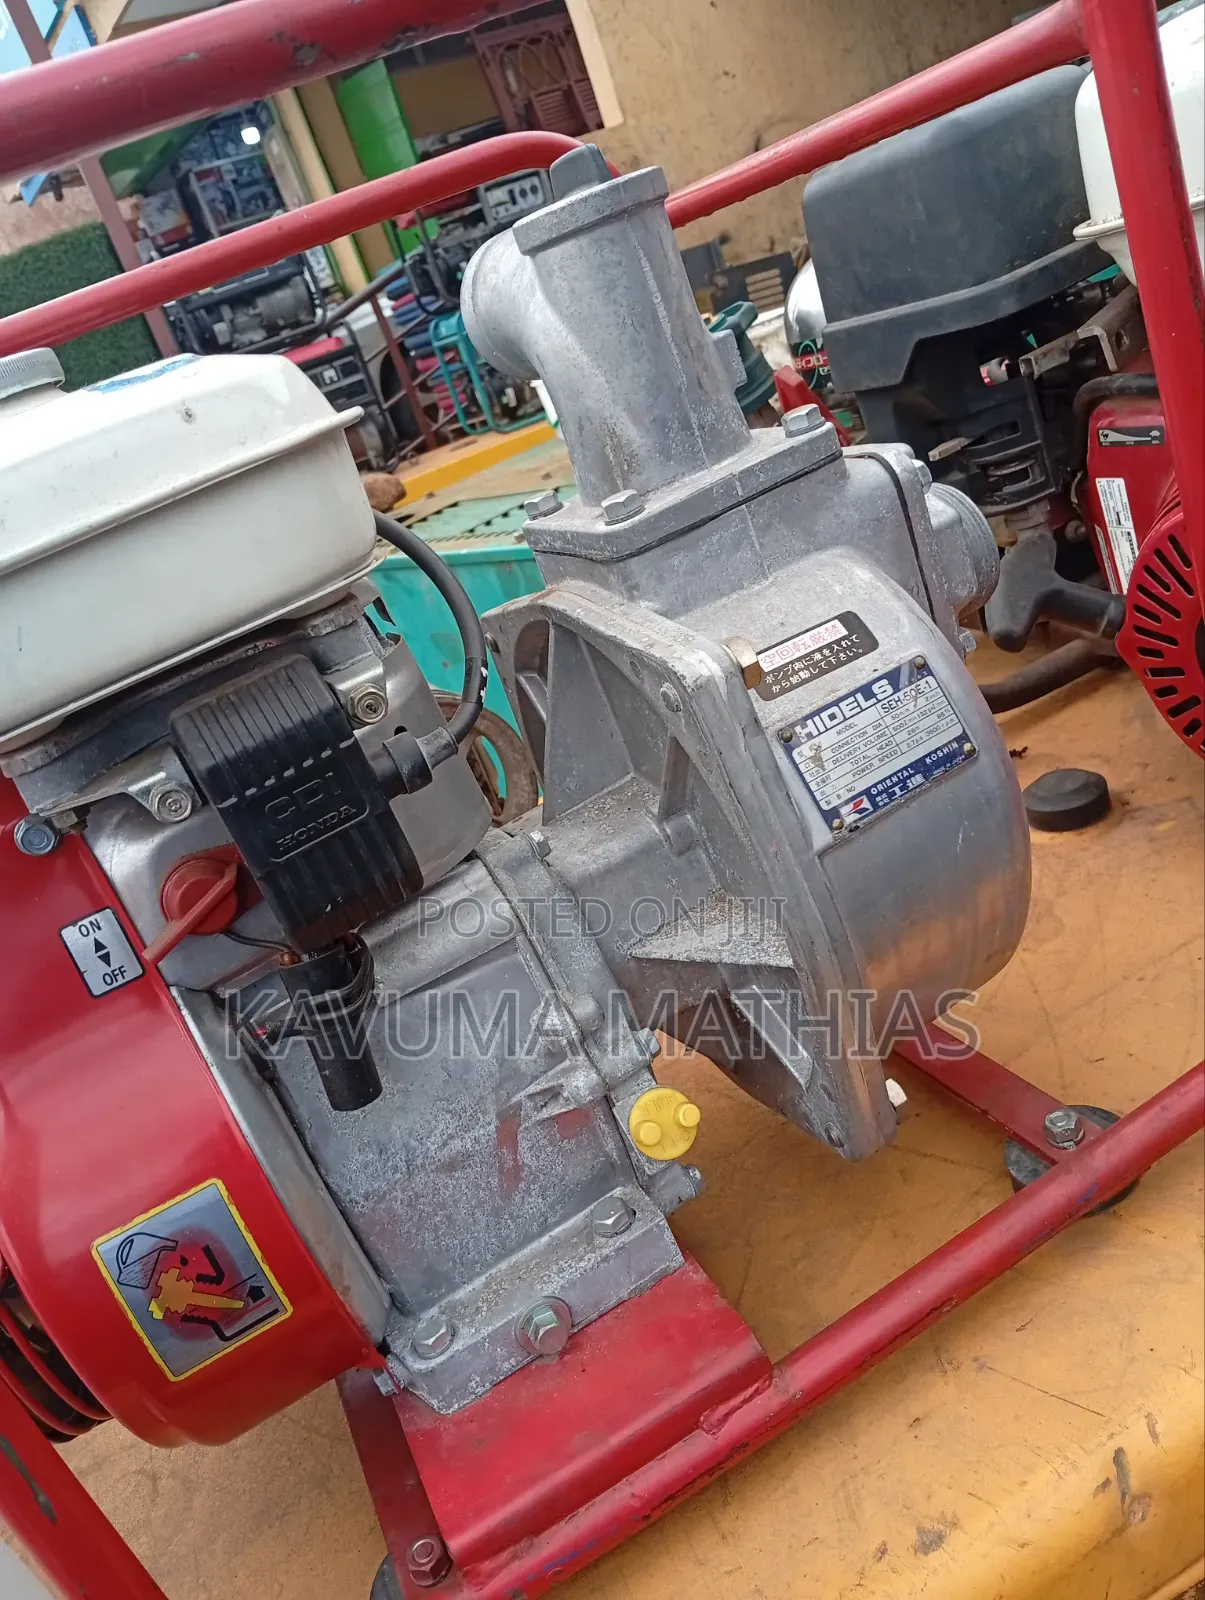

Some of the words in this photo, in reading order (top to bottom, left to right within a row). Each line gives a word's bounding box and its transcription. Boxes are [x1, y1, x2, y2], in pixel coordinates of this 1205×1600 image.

[761, 623, 844, 668] 空回転厳禁
[794, 679, 894, 743] HIDELS
[881, 680, 932, 714] SEH-50E-1
[831, 730, 868, 753] CONNECTION
[872, 722, 883, 731] DIA
[836, 722, 858, 736] MODEL
[832, 746, 861, 765] DELIVERY
[863, 731, 889, 748] VOLUME
[850, 753, 871, 767] TOTAL
[876, 740, 894, 752] HEAD
[852, 763, 875, 778] POWER
[878, 749, 899, 763] SPEED
[870, 767, 915, 795] ORIENTAL
[924, 741, 959, 765] KOSHIN
[276, 805, 357, 851] HONDA
[78, 918, 103, 938] ON
[102, 965, 127, 987] OFF
